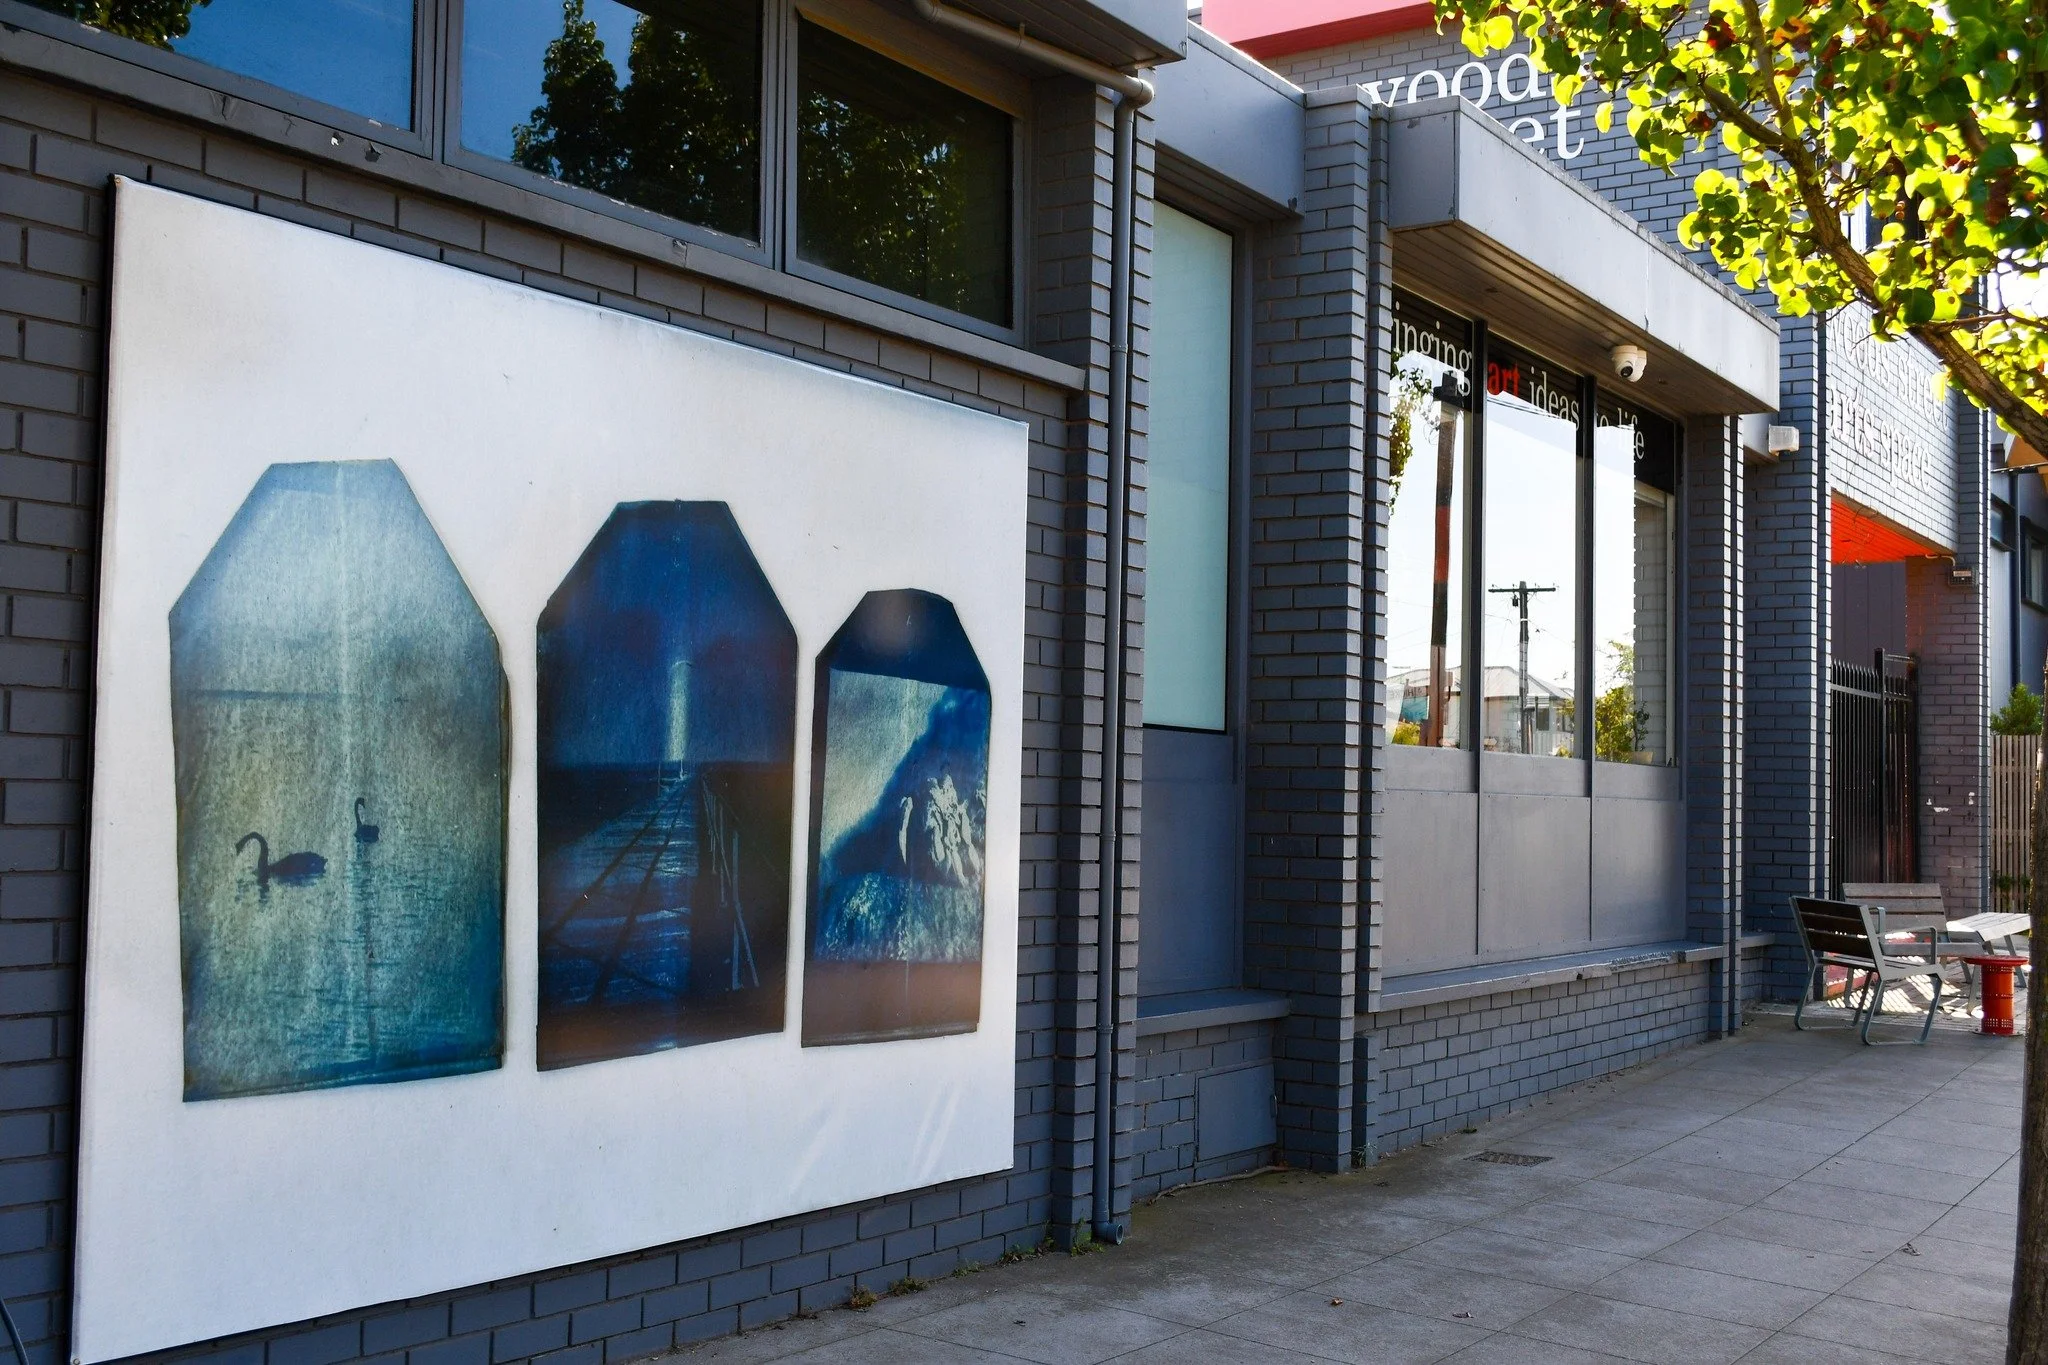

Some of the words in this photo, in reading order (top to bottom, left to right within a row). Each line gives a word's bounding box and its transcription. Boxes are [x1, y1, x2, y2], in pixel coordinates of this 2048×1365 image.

[1362, 38, 1593, 110] ood
[1392, 301, 1473, 397] inging
[1487, 361, 1521, 398] art
[1529, 366, 1580, 432] ideas
[1829, 386, 1875, 459] arts
[1880, 420, 1931, 494] space
